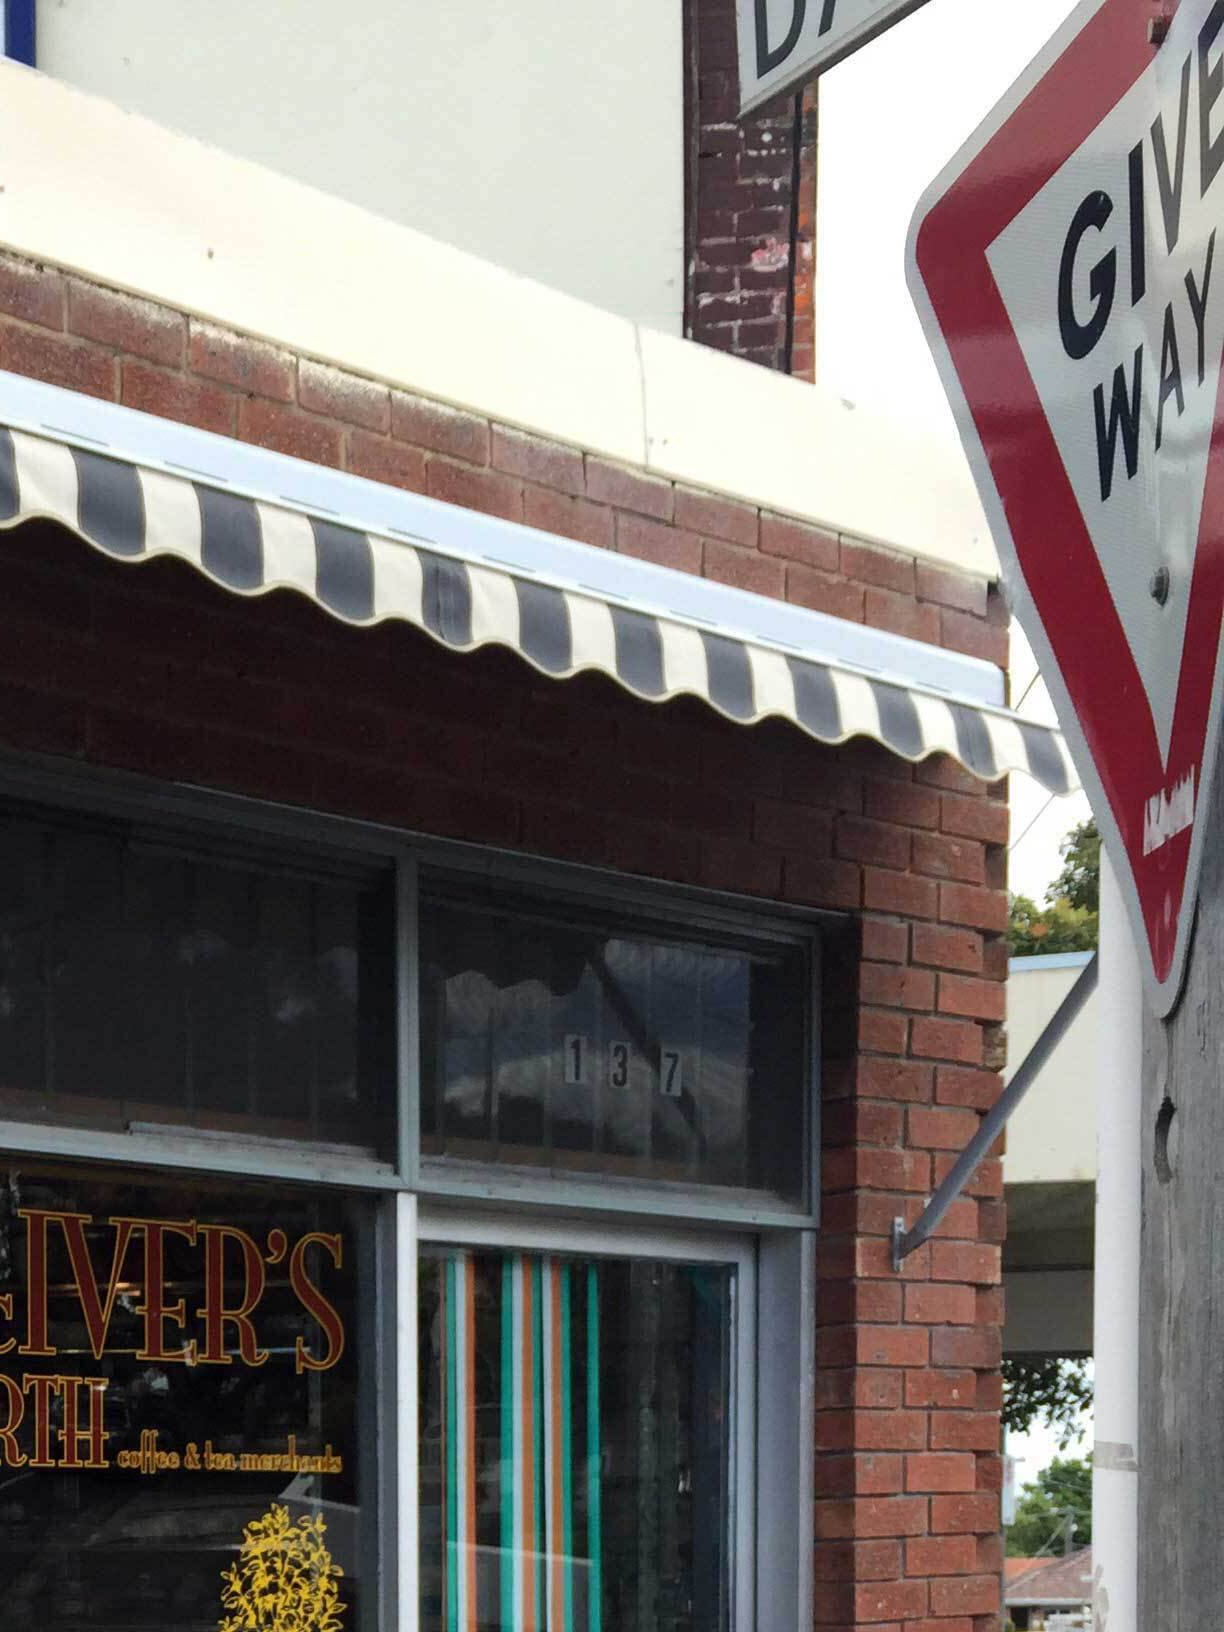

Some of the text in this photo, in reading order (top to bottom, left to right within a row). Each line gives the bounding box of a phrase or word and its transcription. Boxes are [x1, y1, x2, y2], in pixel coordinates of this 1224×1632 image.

[1057, 0, 1224, 361] GIVE
[1093, 226, 1216, 503] WAY
[117, 1428, 344, 1475] coffee & tea merchants
